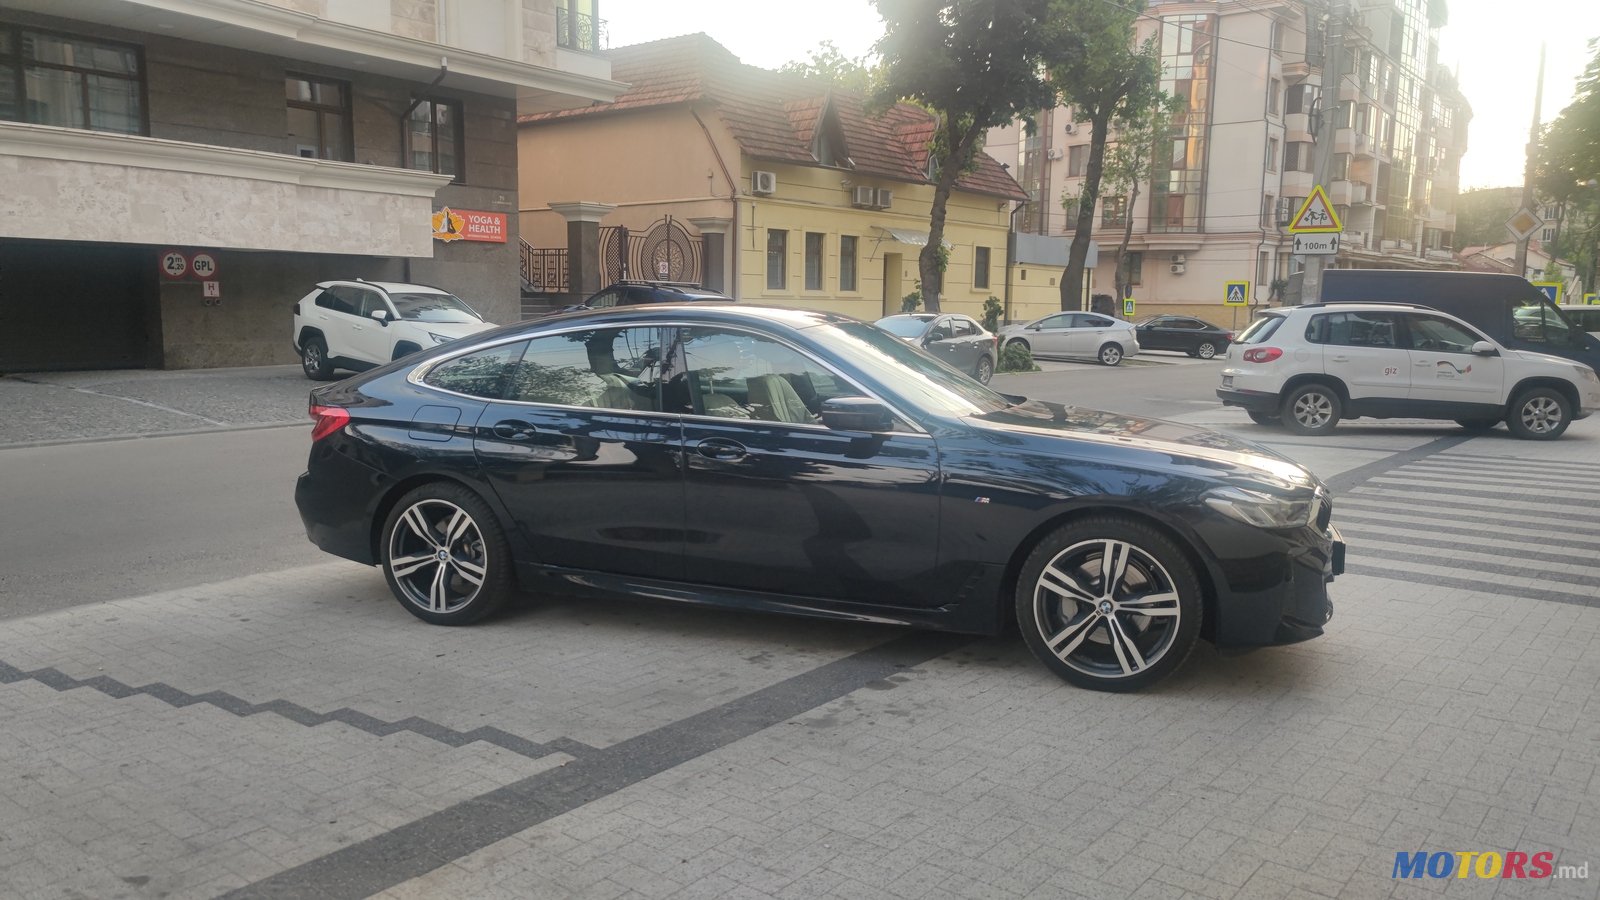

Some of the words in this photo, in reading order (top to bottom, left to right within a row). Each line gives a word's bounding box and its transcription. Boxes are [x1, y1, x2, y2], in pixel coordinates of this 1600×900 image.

[468, 215, 493, 225] YOGA
[494, 217, 501, 225] &
[468, 224, 501, 234] HEALTH
[1304, 242, 1327, 250] 100m
[194, 260, 213, 271] GPL
[1384, 367, 1398, 376] giz
